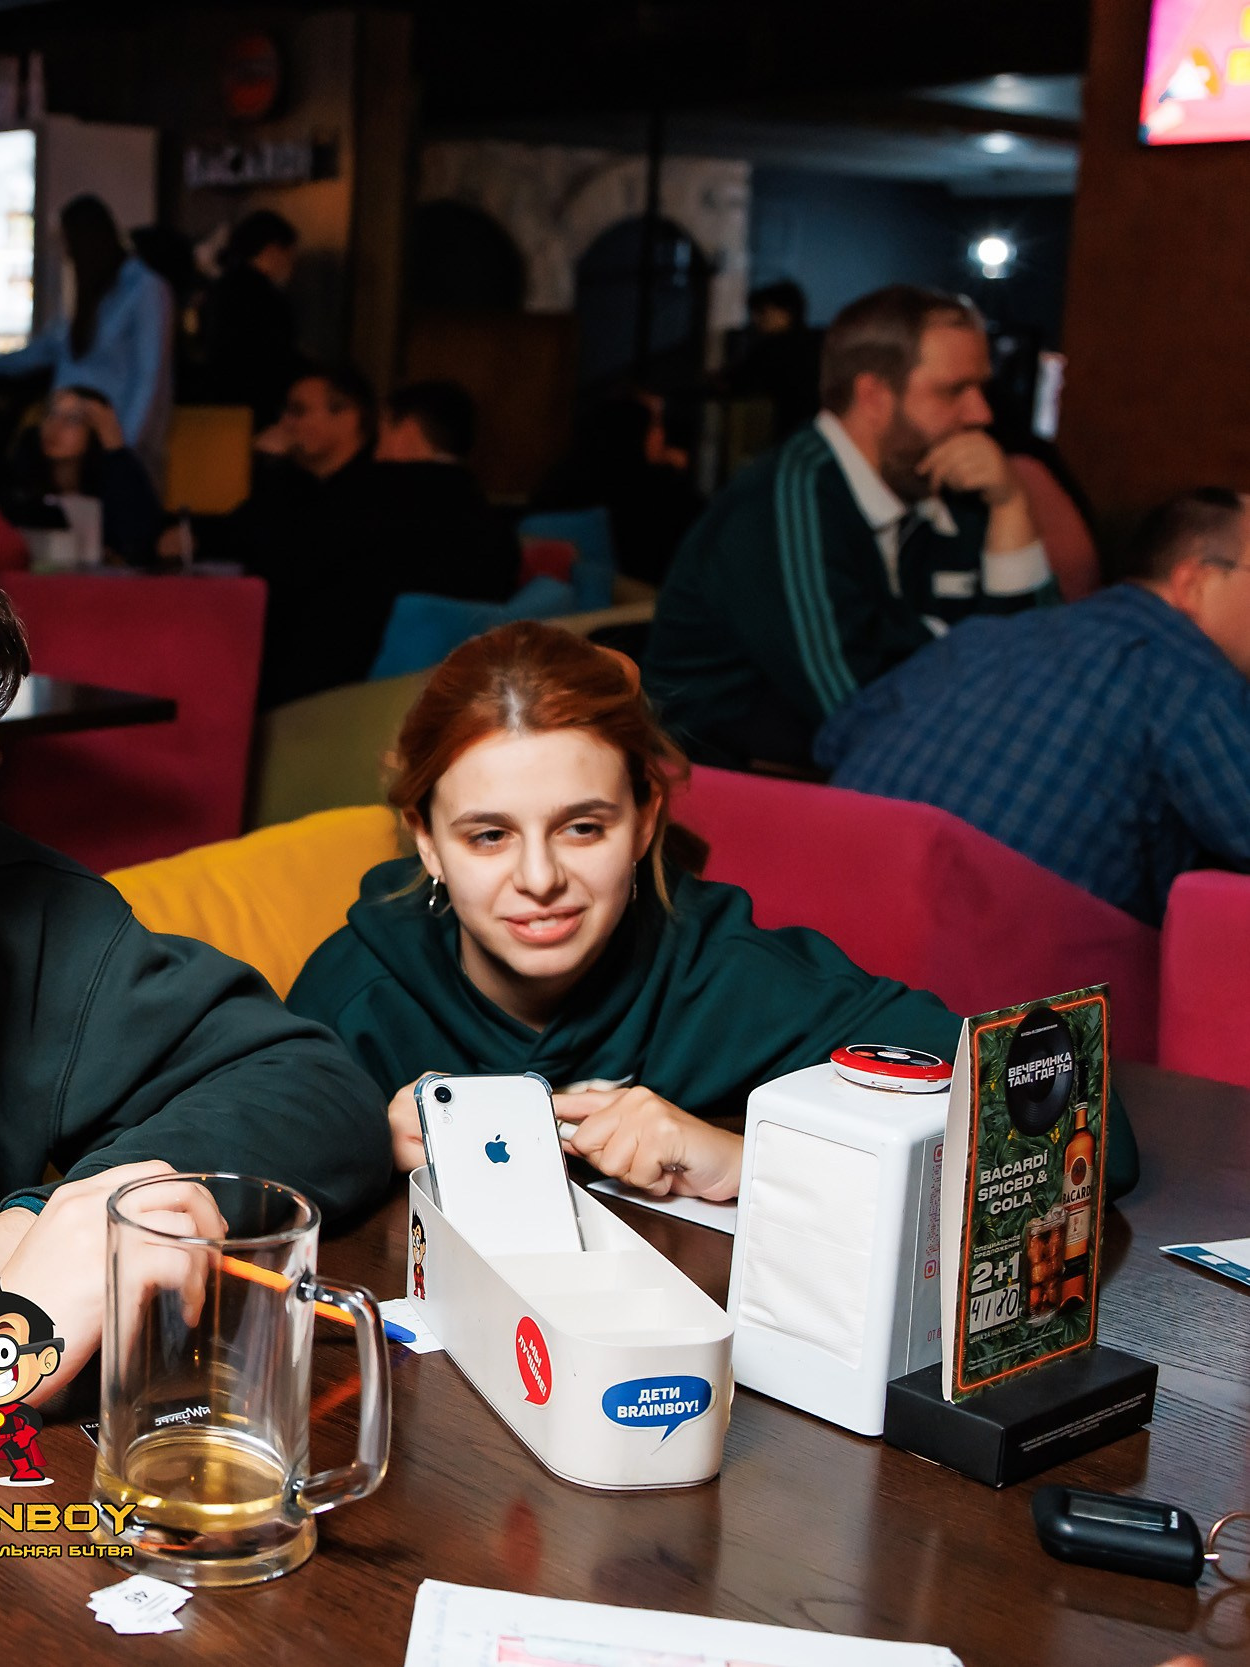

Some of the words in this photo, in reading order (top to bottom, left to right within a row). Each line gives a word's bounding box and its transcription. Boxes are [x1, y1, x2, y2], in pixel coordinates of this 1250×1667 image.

[1008, 1052, 1072, 1077] ВЕЧЕРИНКА
[1008, 1074, 1033, 1088] ТАМ,
[1035, 1066, 1055, 1081] ГДЕ
[1056, 1061, 1073, 1074] ТЫ
[978, 1174, 1034, 1202] SPICED
[1036, 1170, 1048, 1184] &
[990, 1191, 1032, 1215] COLA
[973, 1240, 1020, 1259] ПРЕДЛОЖЕНИЕ
[974, 1234, 1021, 1253] СПЕЦИАЛЬНОЕ
[517, 1334, 547, 1397] ЛУЧШИЕ!
[529, 1339, 542, 1368] МЫ
[638, 1386, 680, 1404] ДЕТИ
[617, 1399, 699, 1418] BRAINBOY!
